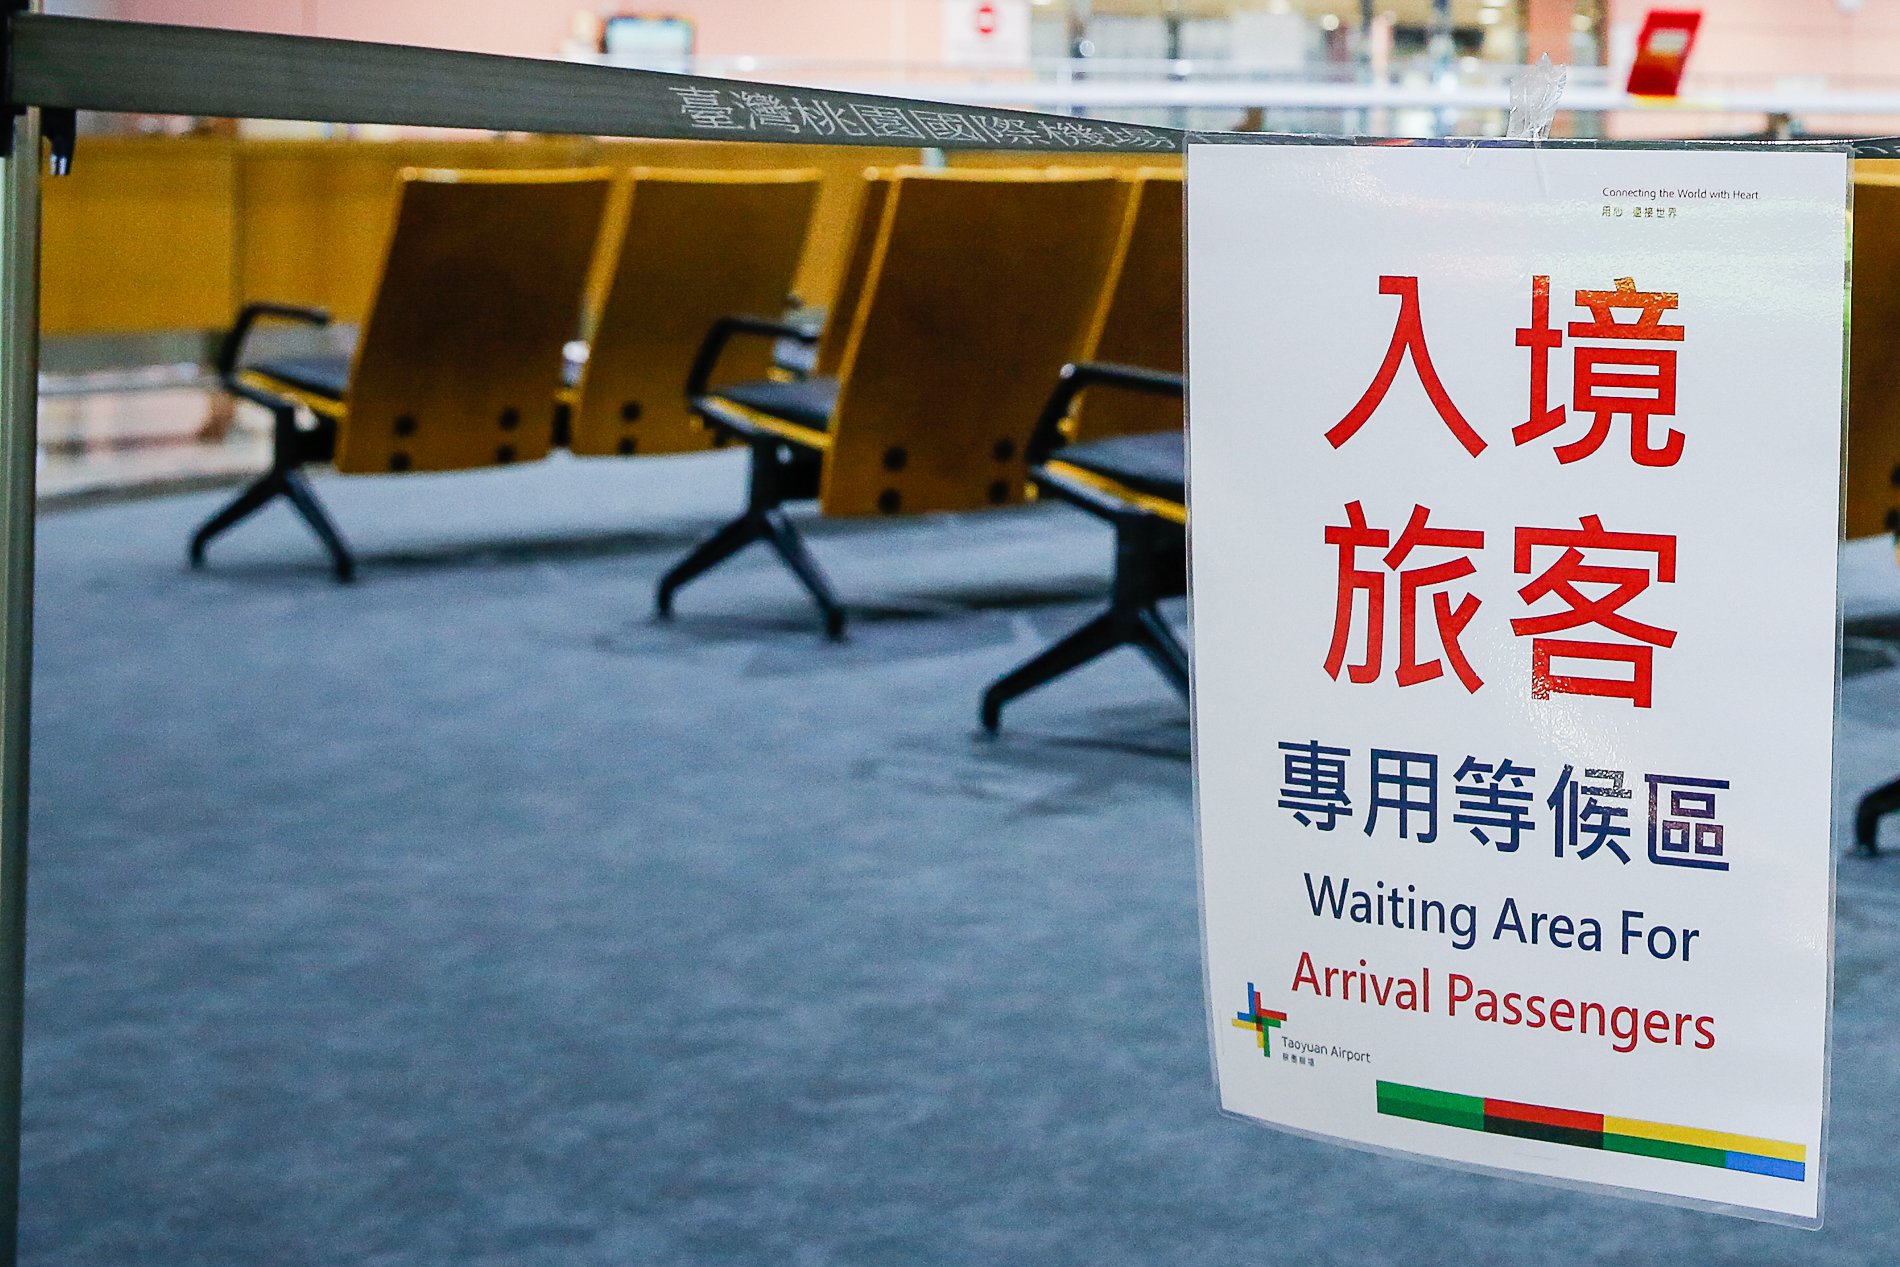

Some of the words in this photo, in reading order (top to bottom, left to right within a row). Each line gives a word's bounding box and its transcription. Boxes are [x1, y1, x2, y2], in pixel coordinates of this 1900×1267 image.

[668, 85, 1176, 149] 臺灣桃園國際機場
[1602, 187, 1657, 201] Connecting
[1659, 188, 1675, 199] the
[1677, 188, 1707, 200] World
[1709, 189, 1730, 200] with
[1732, 190, 1760, 200] Heart
[1324, 274, 1686, 468] 入境
[1323, 499, 1678, 709] 旅客
[1276, 739, 1731, 872] 專用等候區
[1303, 872, 1477, 950] Waiting
[1492, 897, 1603, 953] Area
[1621, 911, 1700, 962] For
[1281, 1036, 1328, 1055] Taoyuan
[1330, 1045, 1372, 1064] Airport
[1291, 951, 1429, 1013] Arrival
[1448, 973, 1716, 1054] Passengers
